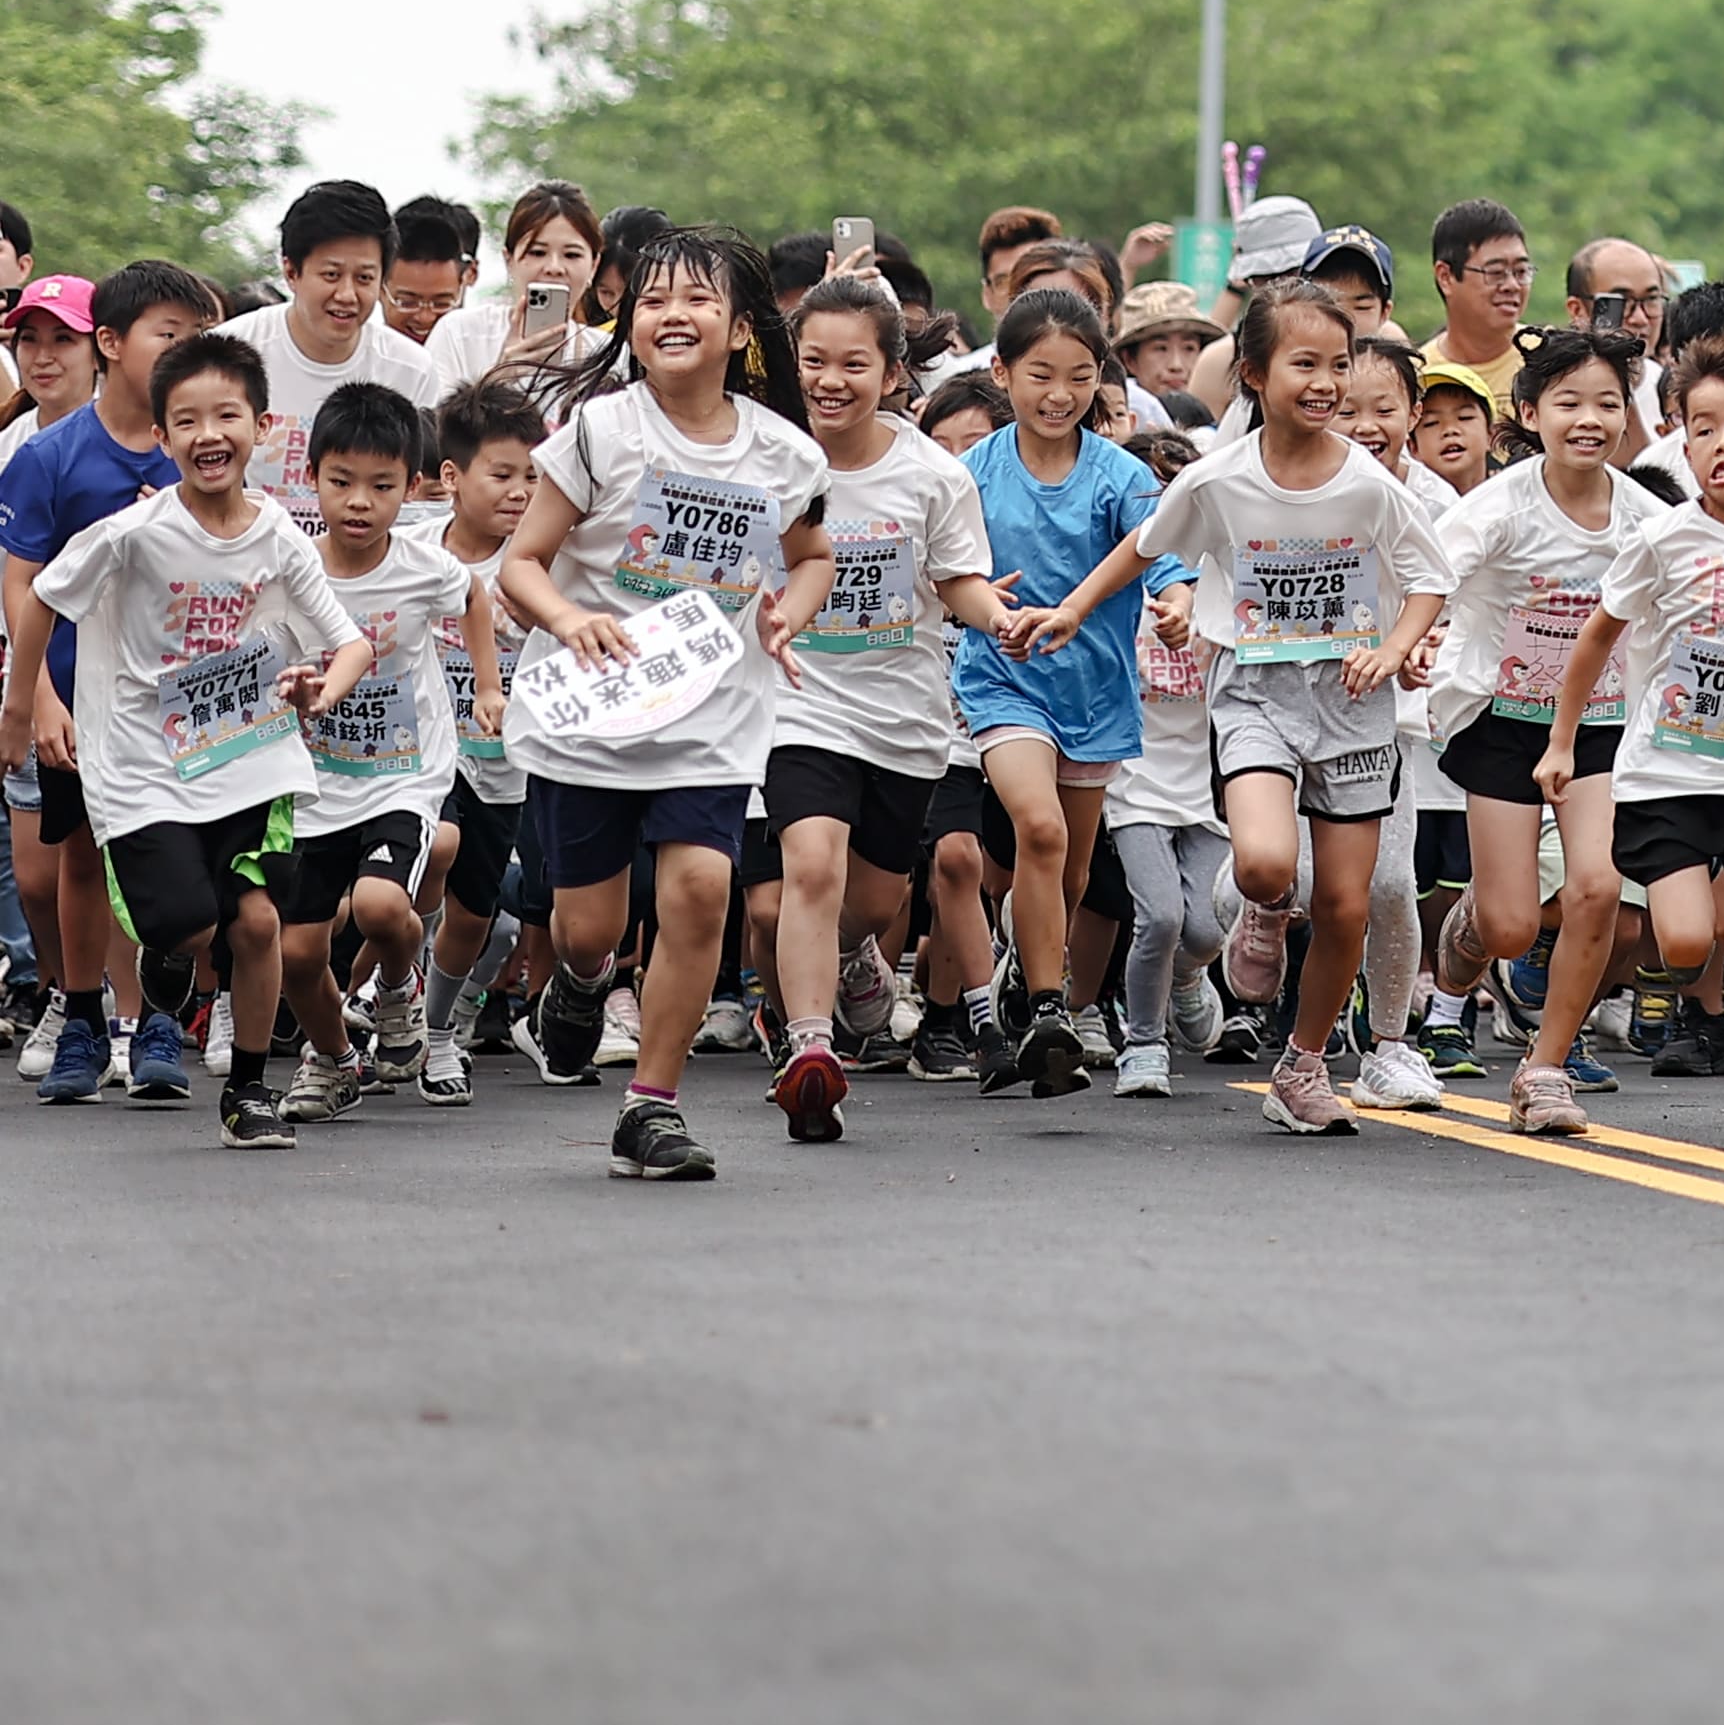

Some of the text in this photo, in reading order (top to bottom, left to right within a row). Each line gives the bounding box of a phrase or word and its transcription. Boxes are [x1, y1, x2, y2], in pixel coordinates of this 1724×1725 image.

[665, 501, 750, 538] Y0786
[661, 530, 743, 567] 盧佳均
[1259, 573, 1345, 597] Y0728
[188, 595, 246, 615] RUN
[185, 615, 241, 635] FOR
[183, 662, 260, 705] Y0771
